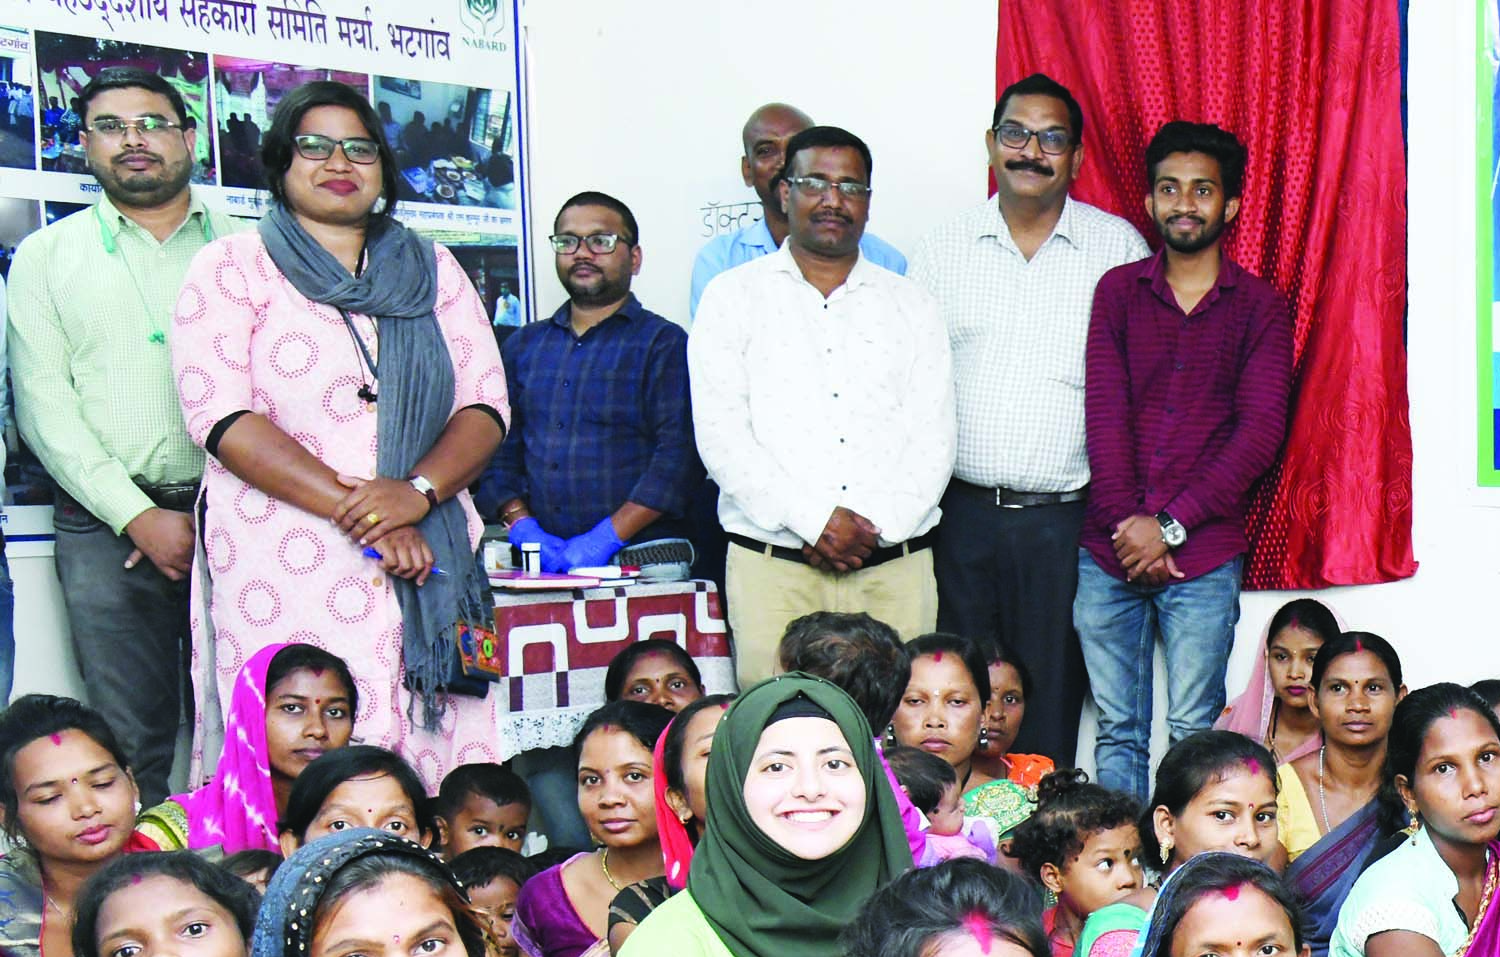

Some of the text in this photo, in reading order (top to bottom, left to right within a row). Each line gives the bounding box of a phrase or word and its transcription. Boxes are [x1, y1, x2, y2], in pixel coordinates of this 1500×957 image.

[267, 0, 327, 44] समिति
[387, 17, 451, 60] भटगांव
[462, 37, 507, 52] NABARD
